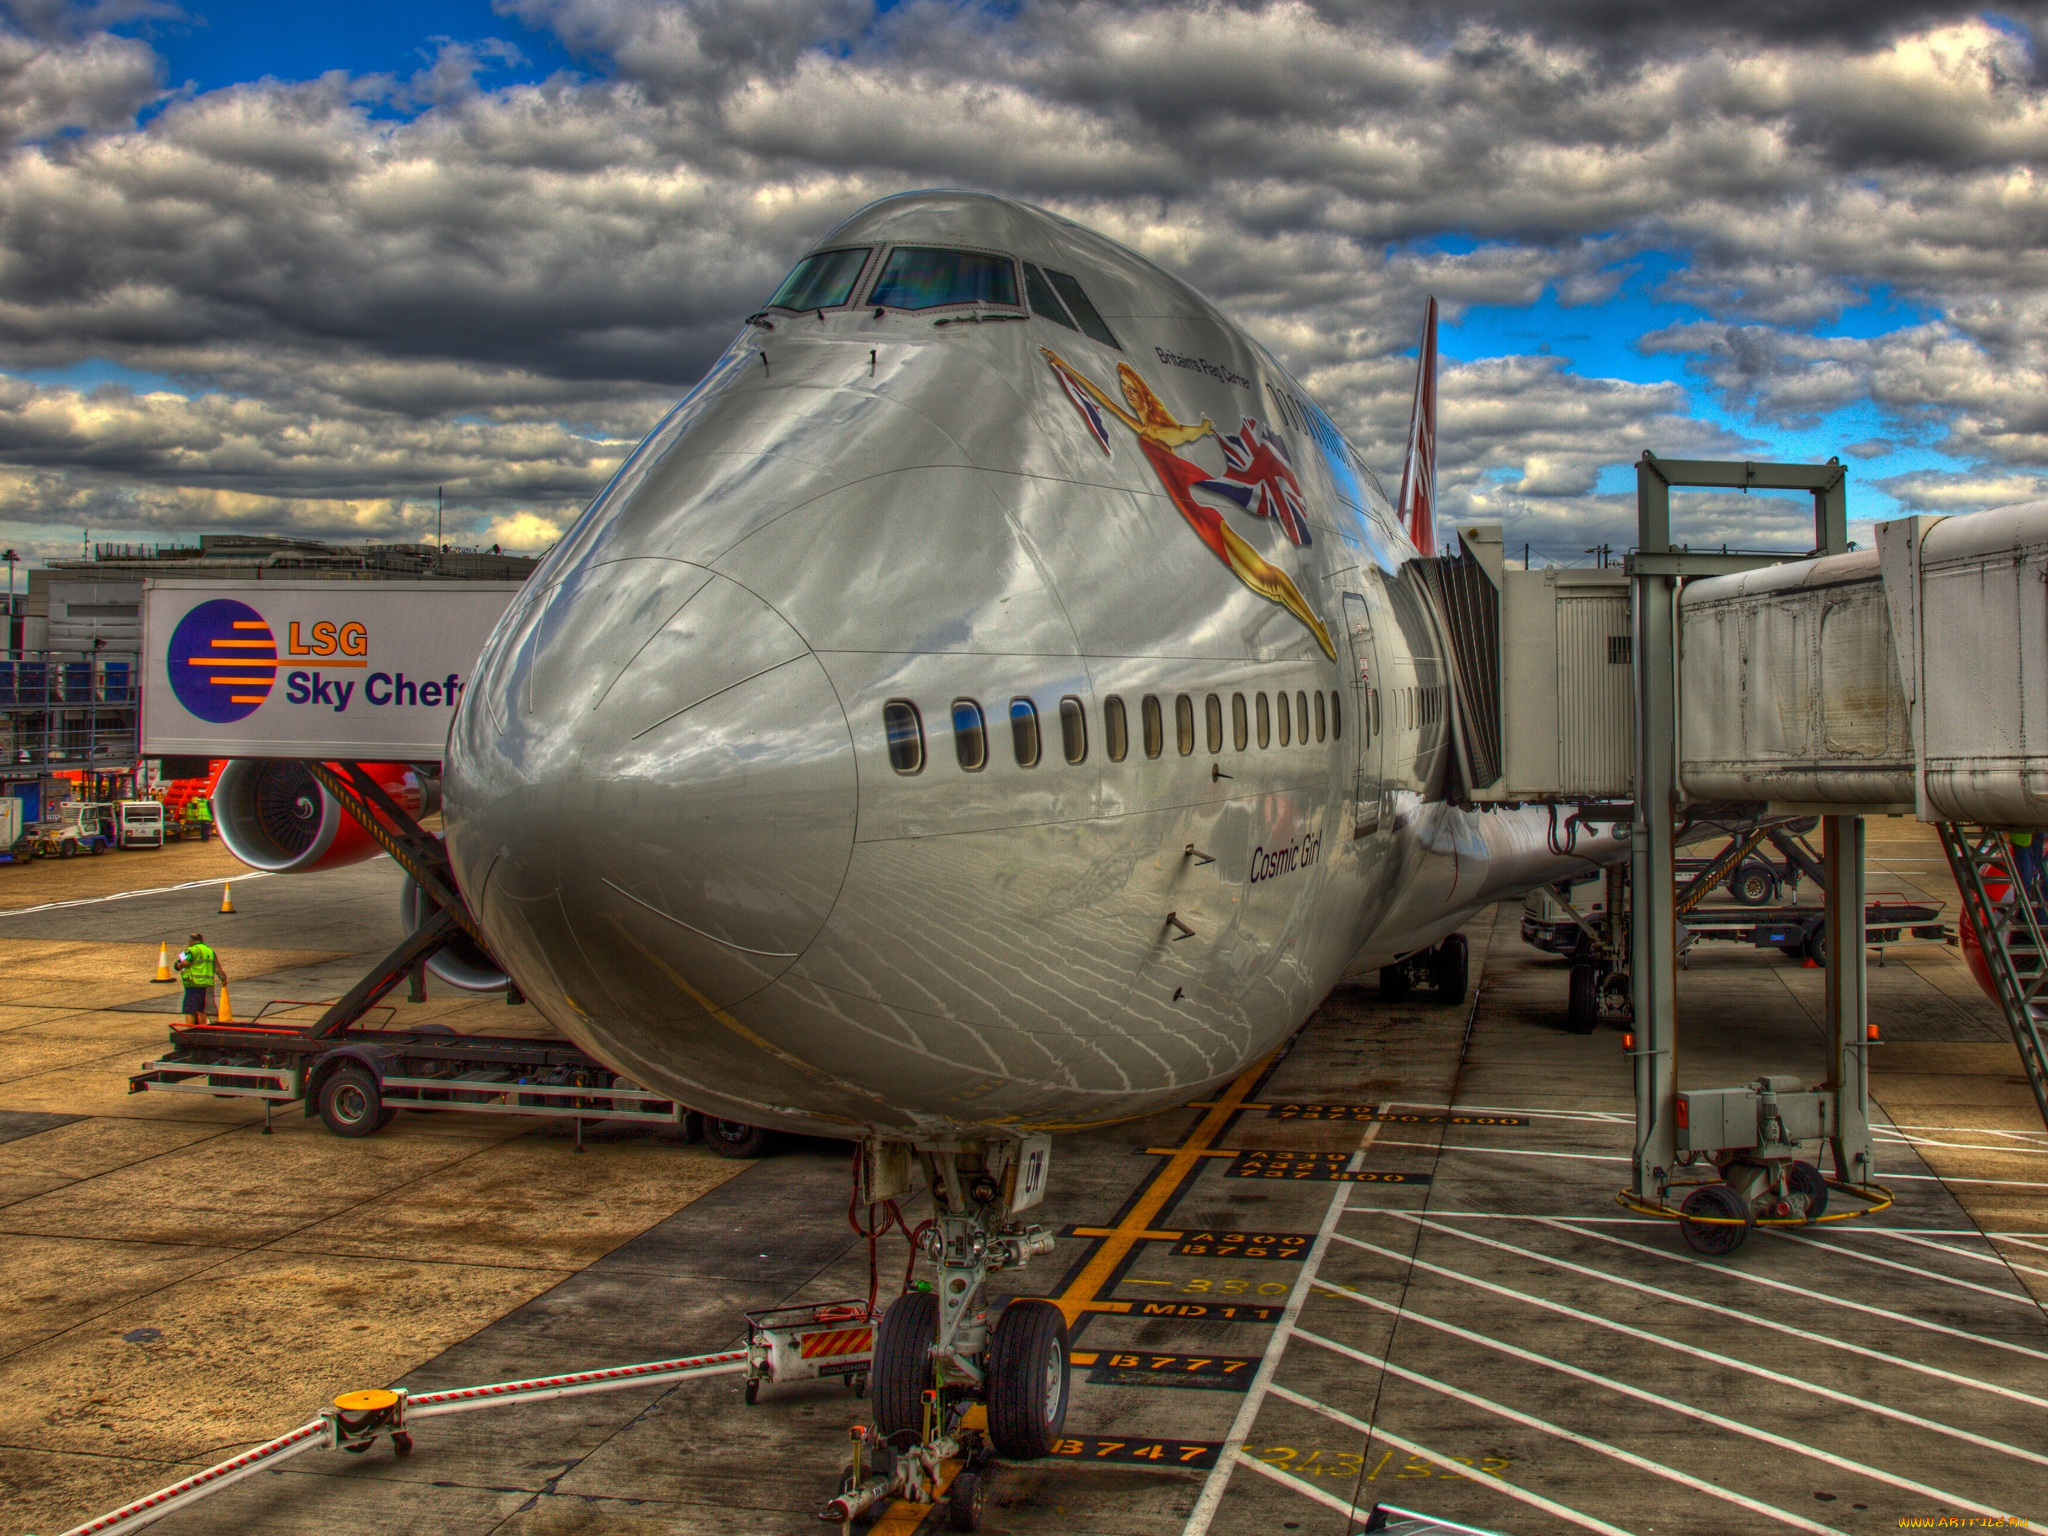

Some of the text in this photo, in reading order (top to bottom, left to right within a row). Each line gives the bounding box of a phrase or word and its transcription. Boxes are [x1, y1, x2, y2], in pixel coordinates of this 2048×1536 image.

[1199, 358, 1225, 384] Flag
[1220, 365, 1252, 391] Carrier
[289, 621, 368, 656] LSG
[287, 671, 355, 712] Sky
[1250, 828, 1323, 883] Cosmic Girl
[1280, 1111, 1344, 1119] 737
[1283, 1104, 1371, 1113] A320
[1241, 1161, 1339, 1171] A321
[1239, 1169, 1405, 1182] 737 800
[1191, 1233, 1306, 1246] A300
[1181, 1244, 1299, 1258] B757
[1108, 1354, 1249, 1374] B777
[1050, 1438, 1208, 1462] B747
